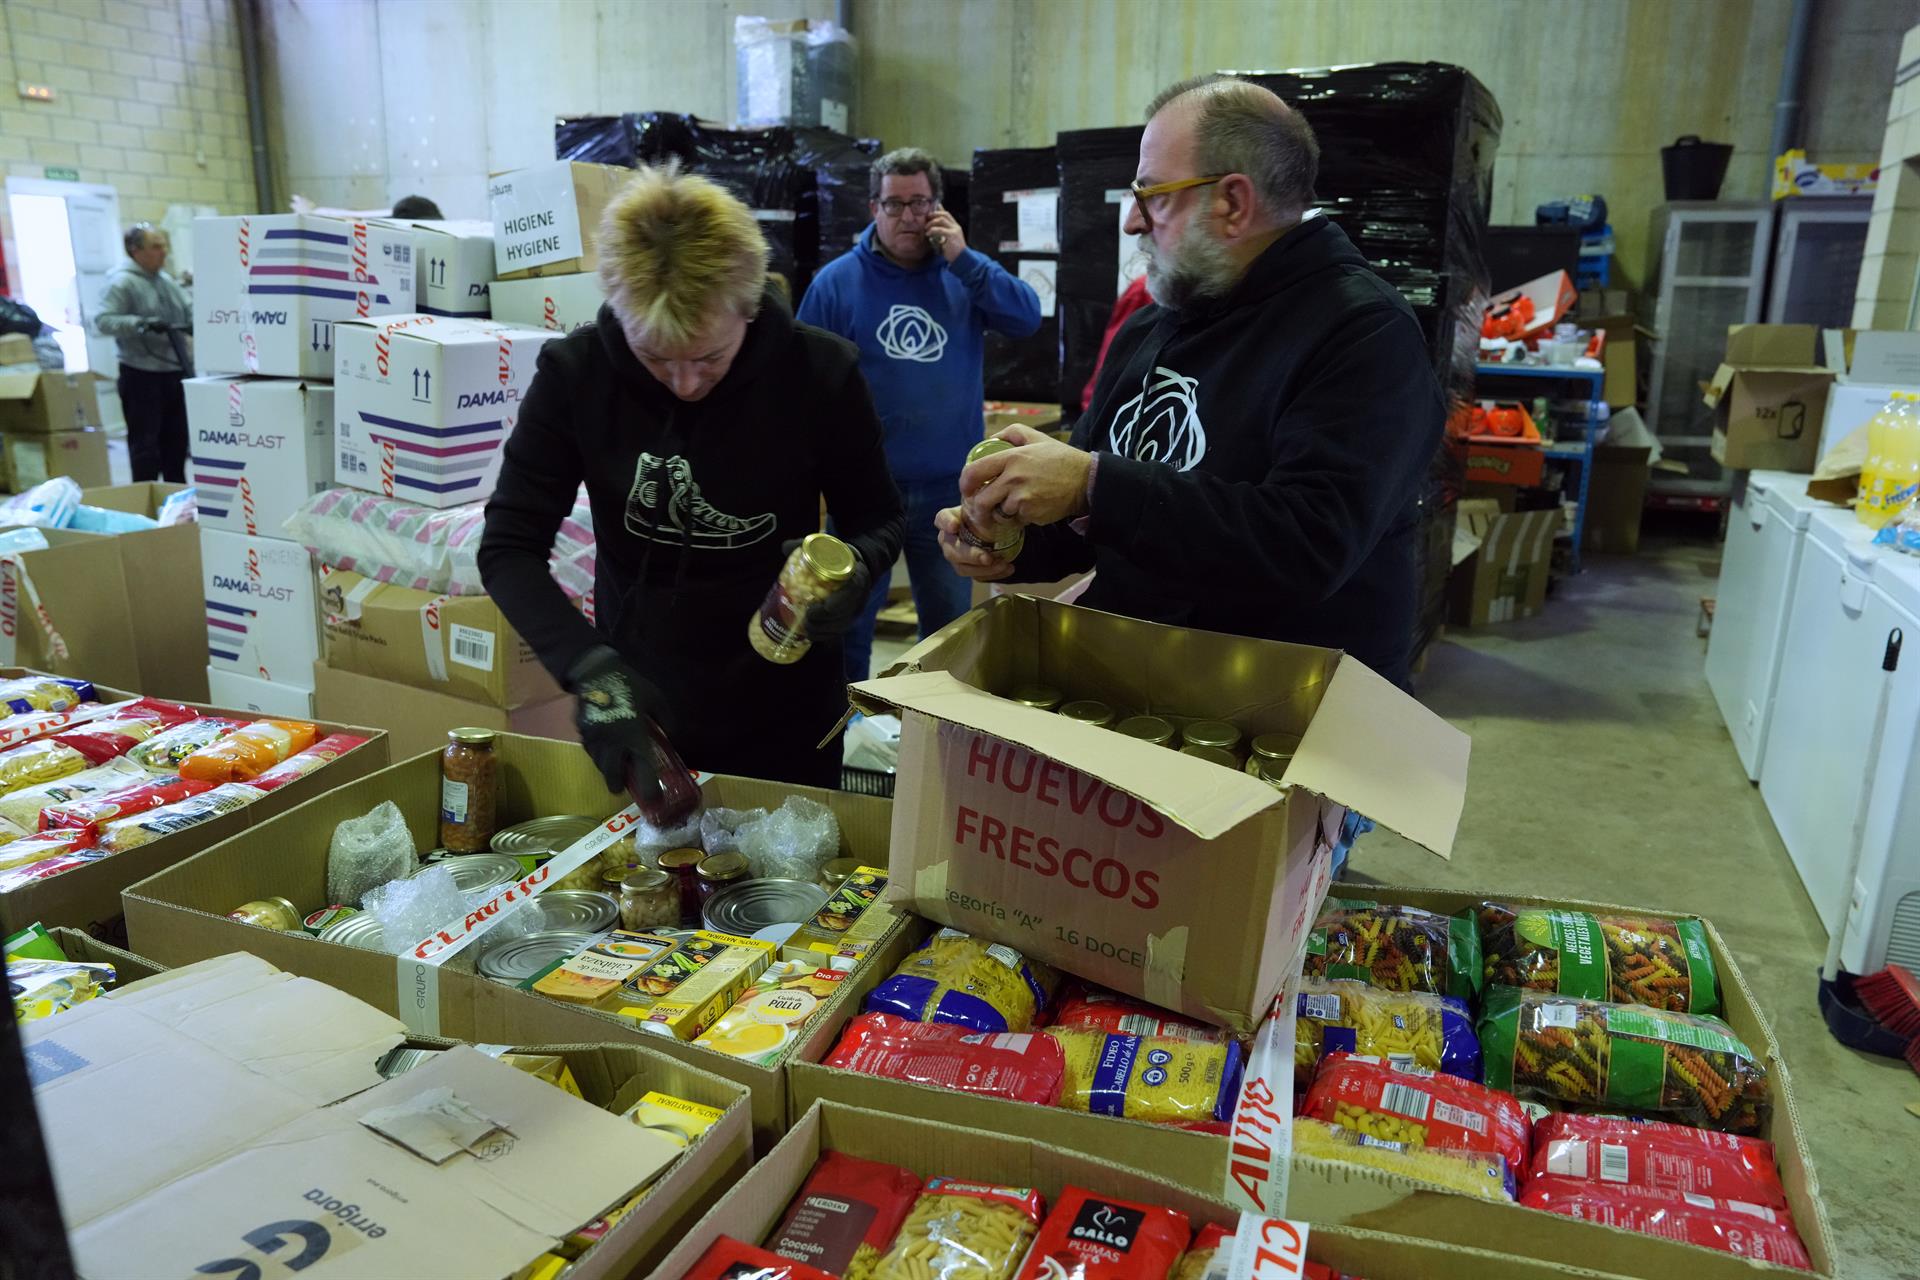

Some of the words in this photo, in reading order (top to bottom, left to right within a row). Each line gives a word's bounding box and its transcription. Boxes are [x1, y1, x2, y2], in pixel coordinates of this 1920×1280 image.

[504, 210, 555, 236] HIGIENE
[506, 235, 561, 261] HYGIENE
[457, 388, 523, 410] DAMAPL
[198, 429, 286, 449] DAMAPLAST
[380, 441, 396, 498] VIJO
[212, 575, 295, 603] DAMAPLAST
[967, 737, 1165, 839] HUEVOS
[955, 805, 1160, 910] FRESCOS
[415, 866, 551, 960] CLAVIJO
[945, 889, 1007, 922] tegoría
[1055, 926, 1080, 946] 16
[1085, 936, 1147, 969] DOCE
[580, 955, 634, 970] Calabaza
[597, 966, 620, 977] Crema
[416, 964, 427, 1009] GRUPO
[768, 999, 802, 1011] POLLO
[1102, 1040, 1120, 1068] FIDEO
[1110, 1056, 1131, 1093] CABELLO
[1230, 1076, 1282, 1213] AVIJO
[303, 1188, 388, 1239] errigora
[816, 1199, 848, 1211] EROSKI
[780, 1237, 824, 1254] Cocción
[1073, 1226, 1128, 1247] GALLO
[1068, 1239, 1120, 1264] PLUMAS
